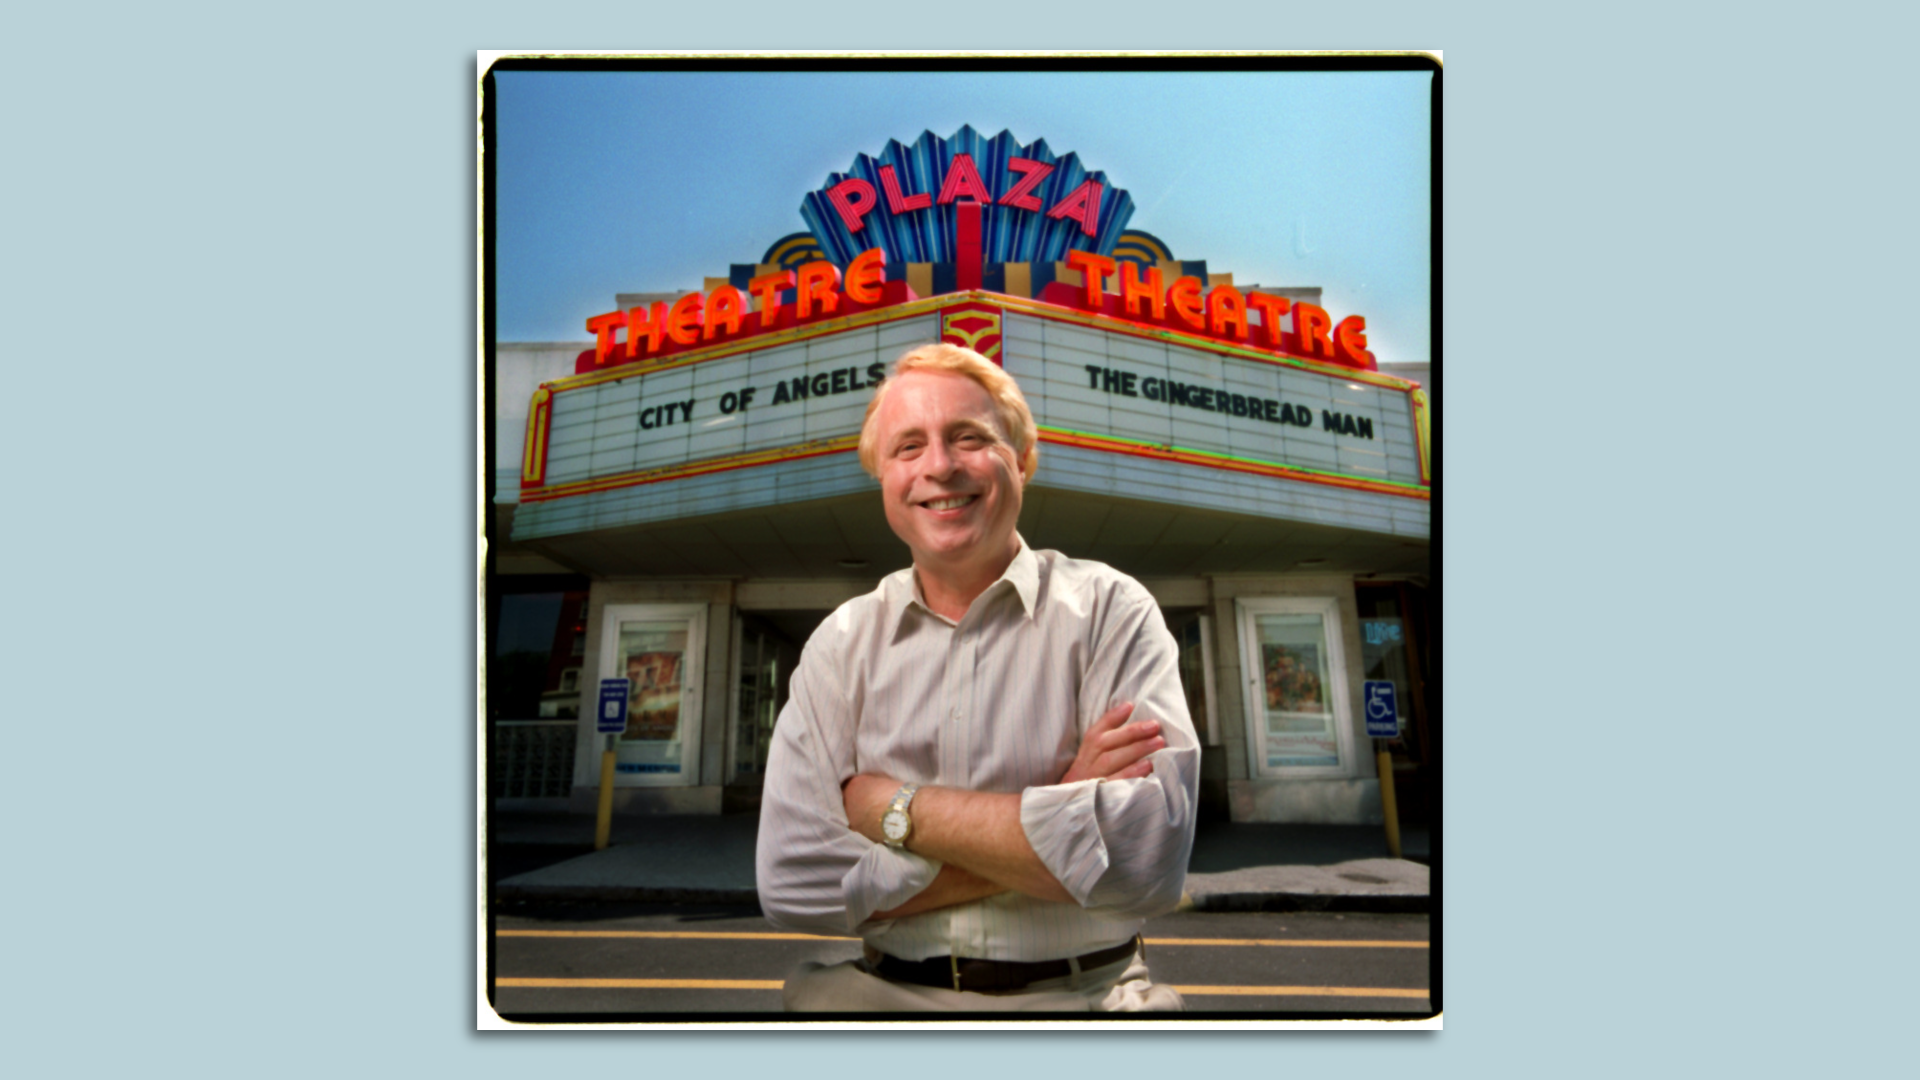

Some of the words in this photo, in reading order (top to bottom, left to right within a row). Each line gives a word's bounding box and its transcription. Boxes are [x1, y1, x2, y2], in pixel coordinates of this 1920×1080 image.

[825, 153, 1104, 237] PLAZA
[586, 247, 886, 365] THEATRE
[1067, 249, 1371, 370] THEATRE
[639, 398, 695, 430] CITY
[719, 387, 756, 414] OF
[772, 362, 886, 405] ANGELS
[1085, 366, 1138, 398] THE
[1142, 378, 1313, 429] GINGERBREAD
[1323, 410, 1374, 440] MAN
